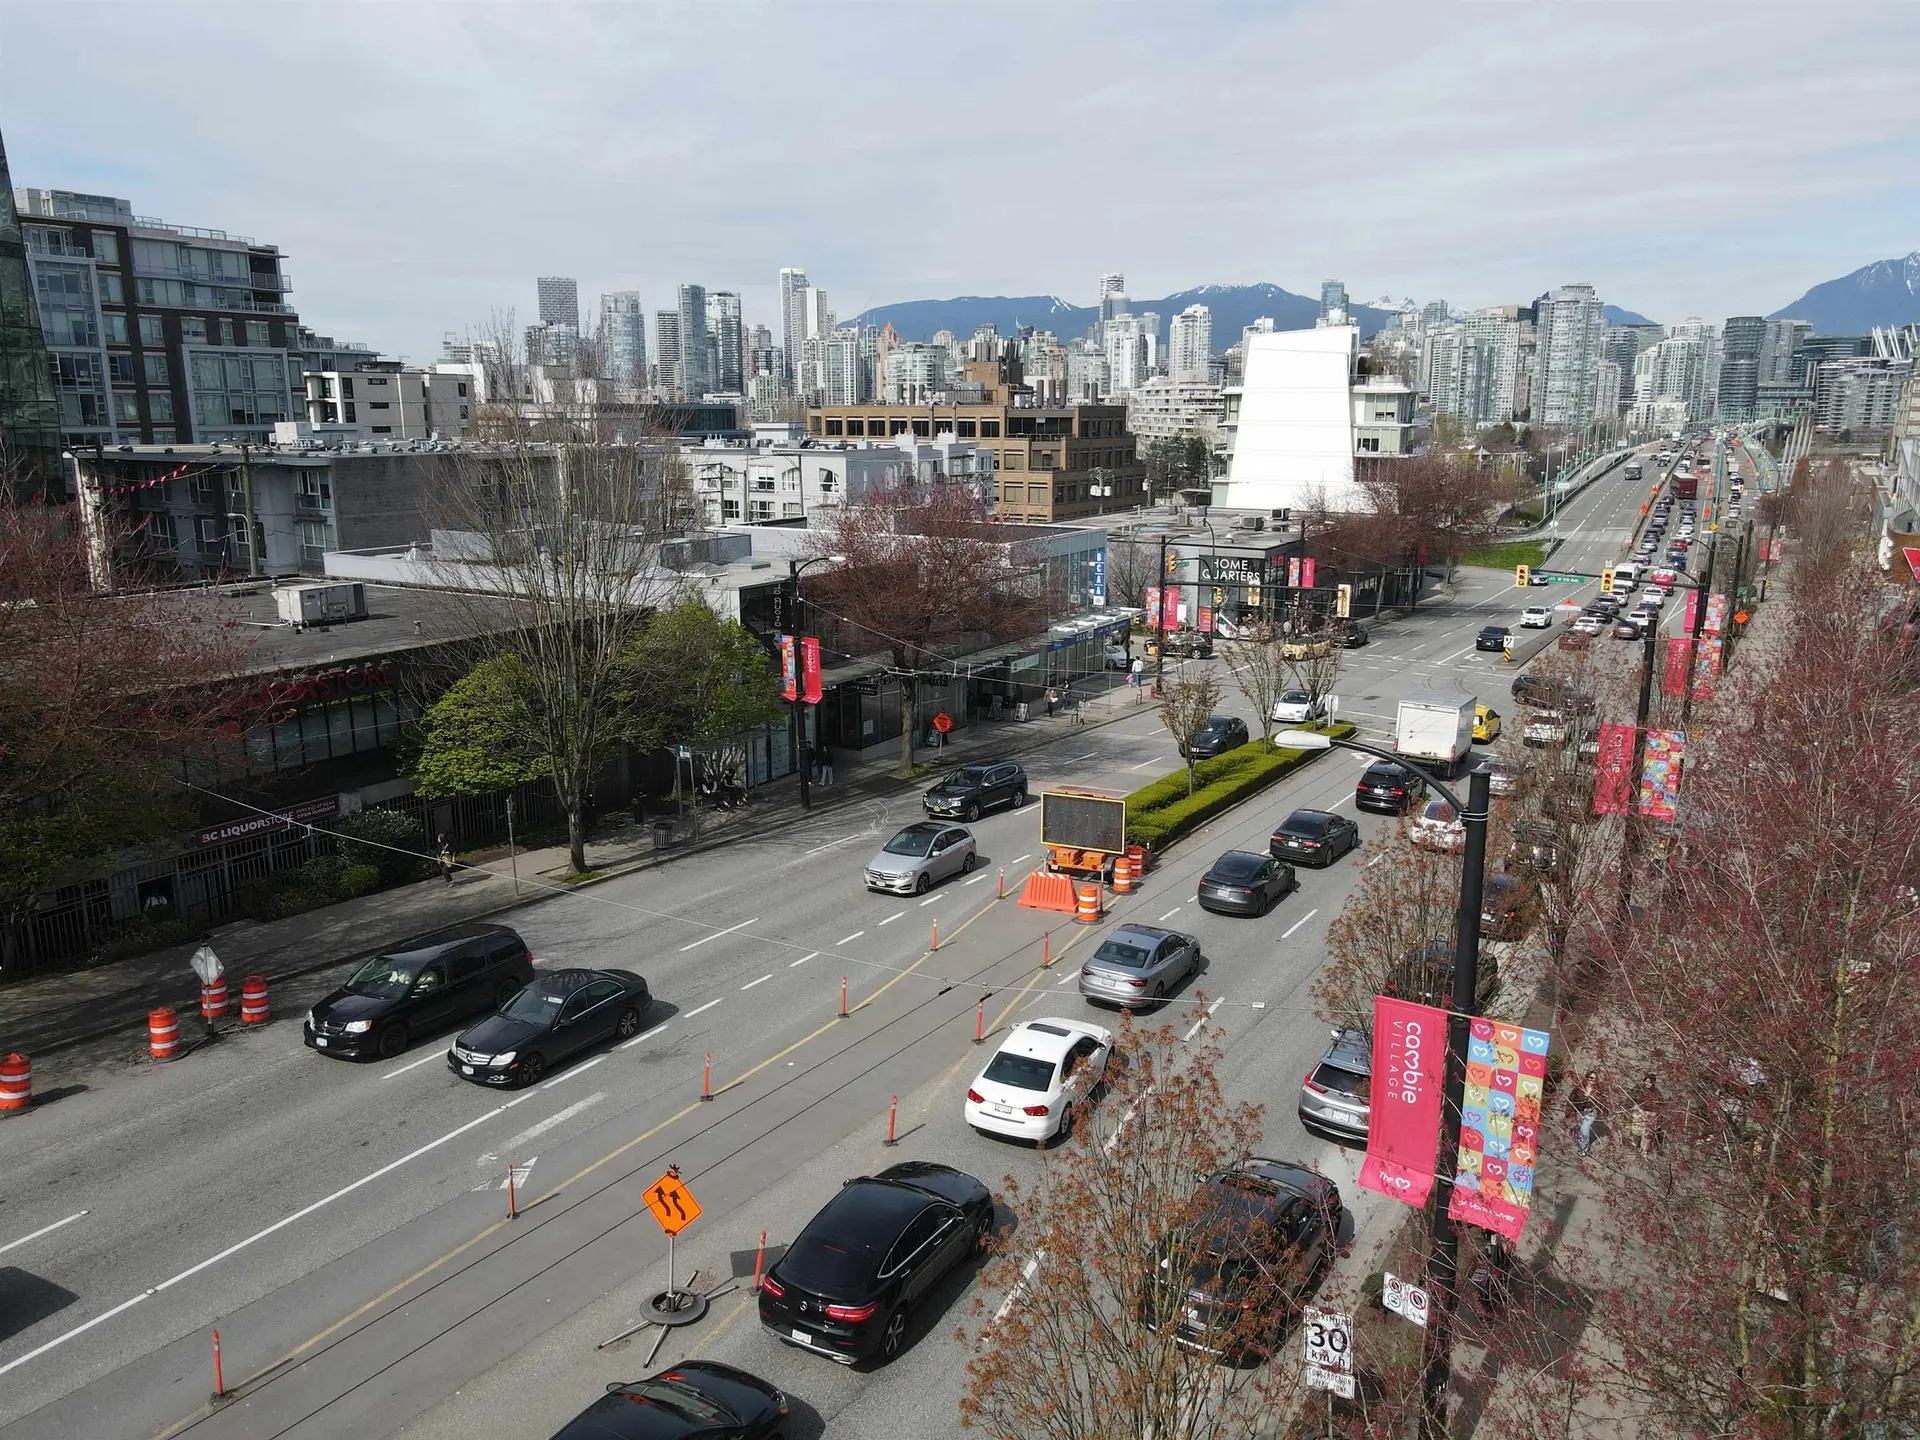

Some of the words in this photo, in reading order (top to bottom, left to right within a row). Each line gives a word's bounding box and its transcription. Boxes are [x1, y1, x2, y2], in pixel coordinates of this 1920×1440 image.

[1213, 558, 1249, 571] HOME
[201, 831, 218, 843] BC
[1387, 1020, 1404, 1100] VILLAGE
[1401, 1021, 1424, 1104] cambie
[1378, 1170, 1394, 1184] The
[1310, 1322, 1348, 1354] 30
[1311, 1348, 1346, 1367] km/h
